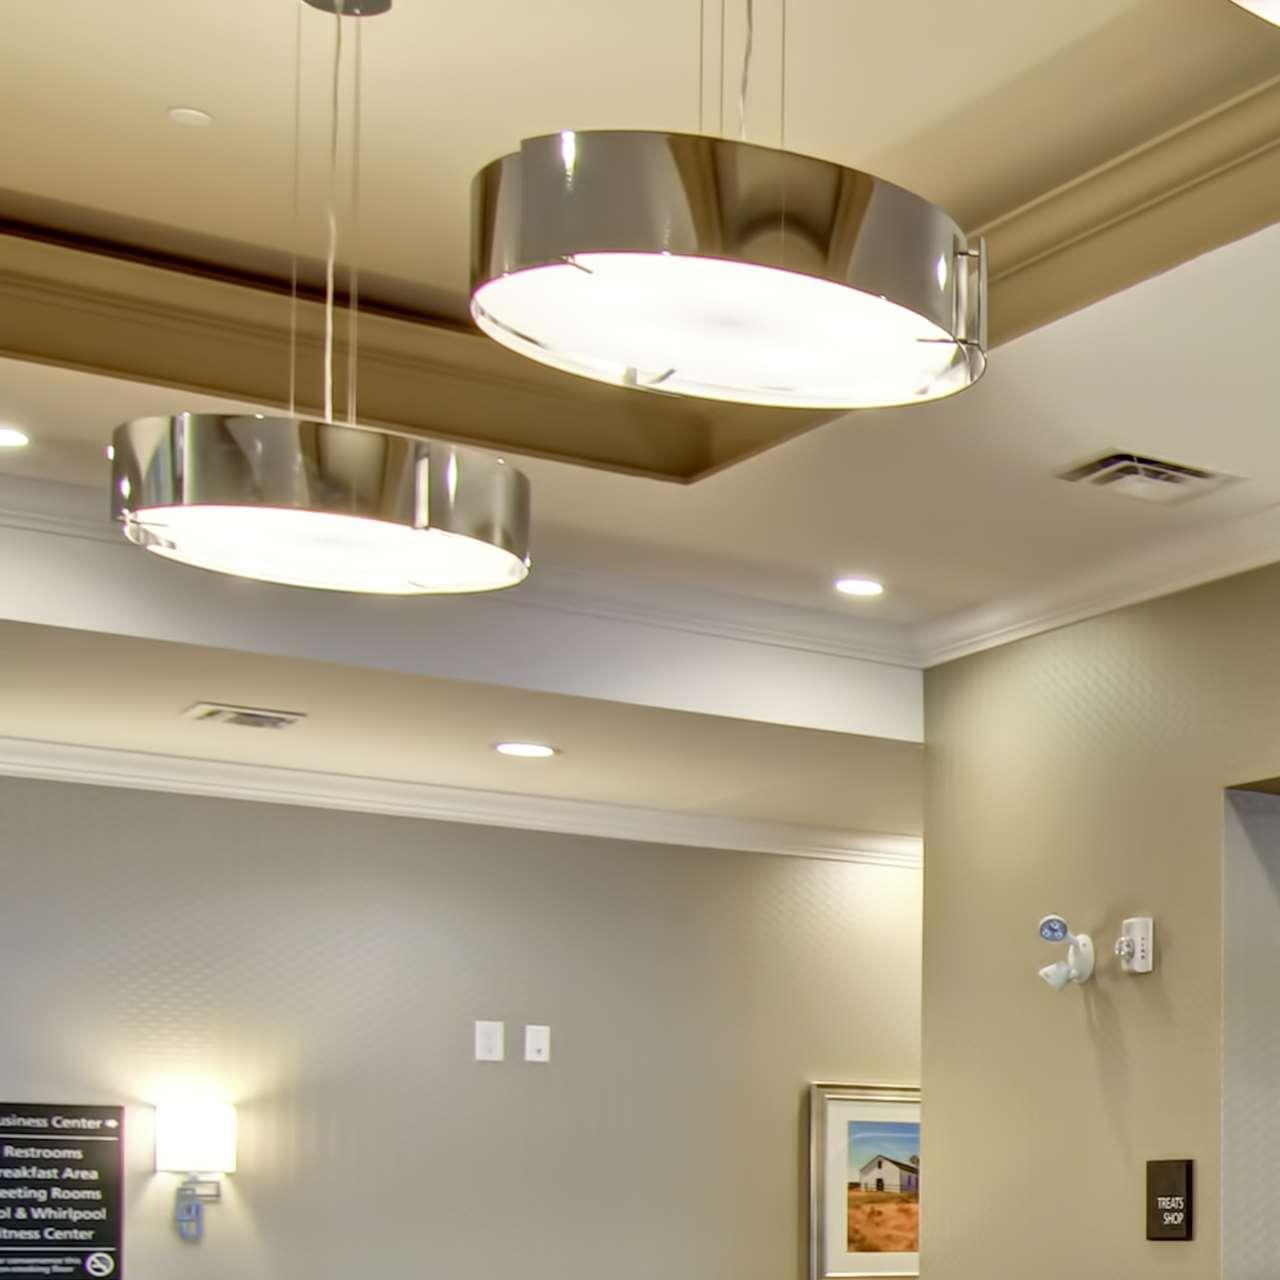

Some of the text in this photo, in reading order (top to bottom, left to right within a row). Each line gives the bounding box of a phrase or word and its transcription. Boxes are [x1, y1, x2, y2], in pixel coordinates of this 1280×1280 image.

[51, 1115, 102, 1129] Center
[3, 1144, 84, 1160] Restrooms
[61, 1166, 100, 1180] Area
[50, 1186, 102, 1200] Rooms
[1157, 1196, 1184, 1210] TREATS
[14, 1206, 28, 1220] &
[30, 1206, 107, 1223] Whirlpool
[1163, 1211, 1185, 1225] SHOP
[42, 1226, 95, 1240] Center
